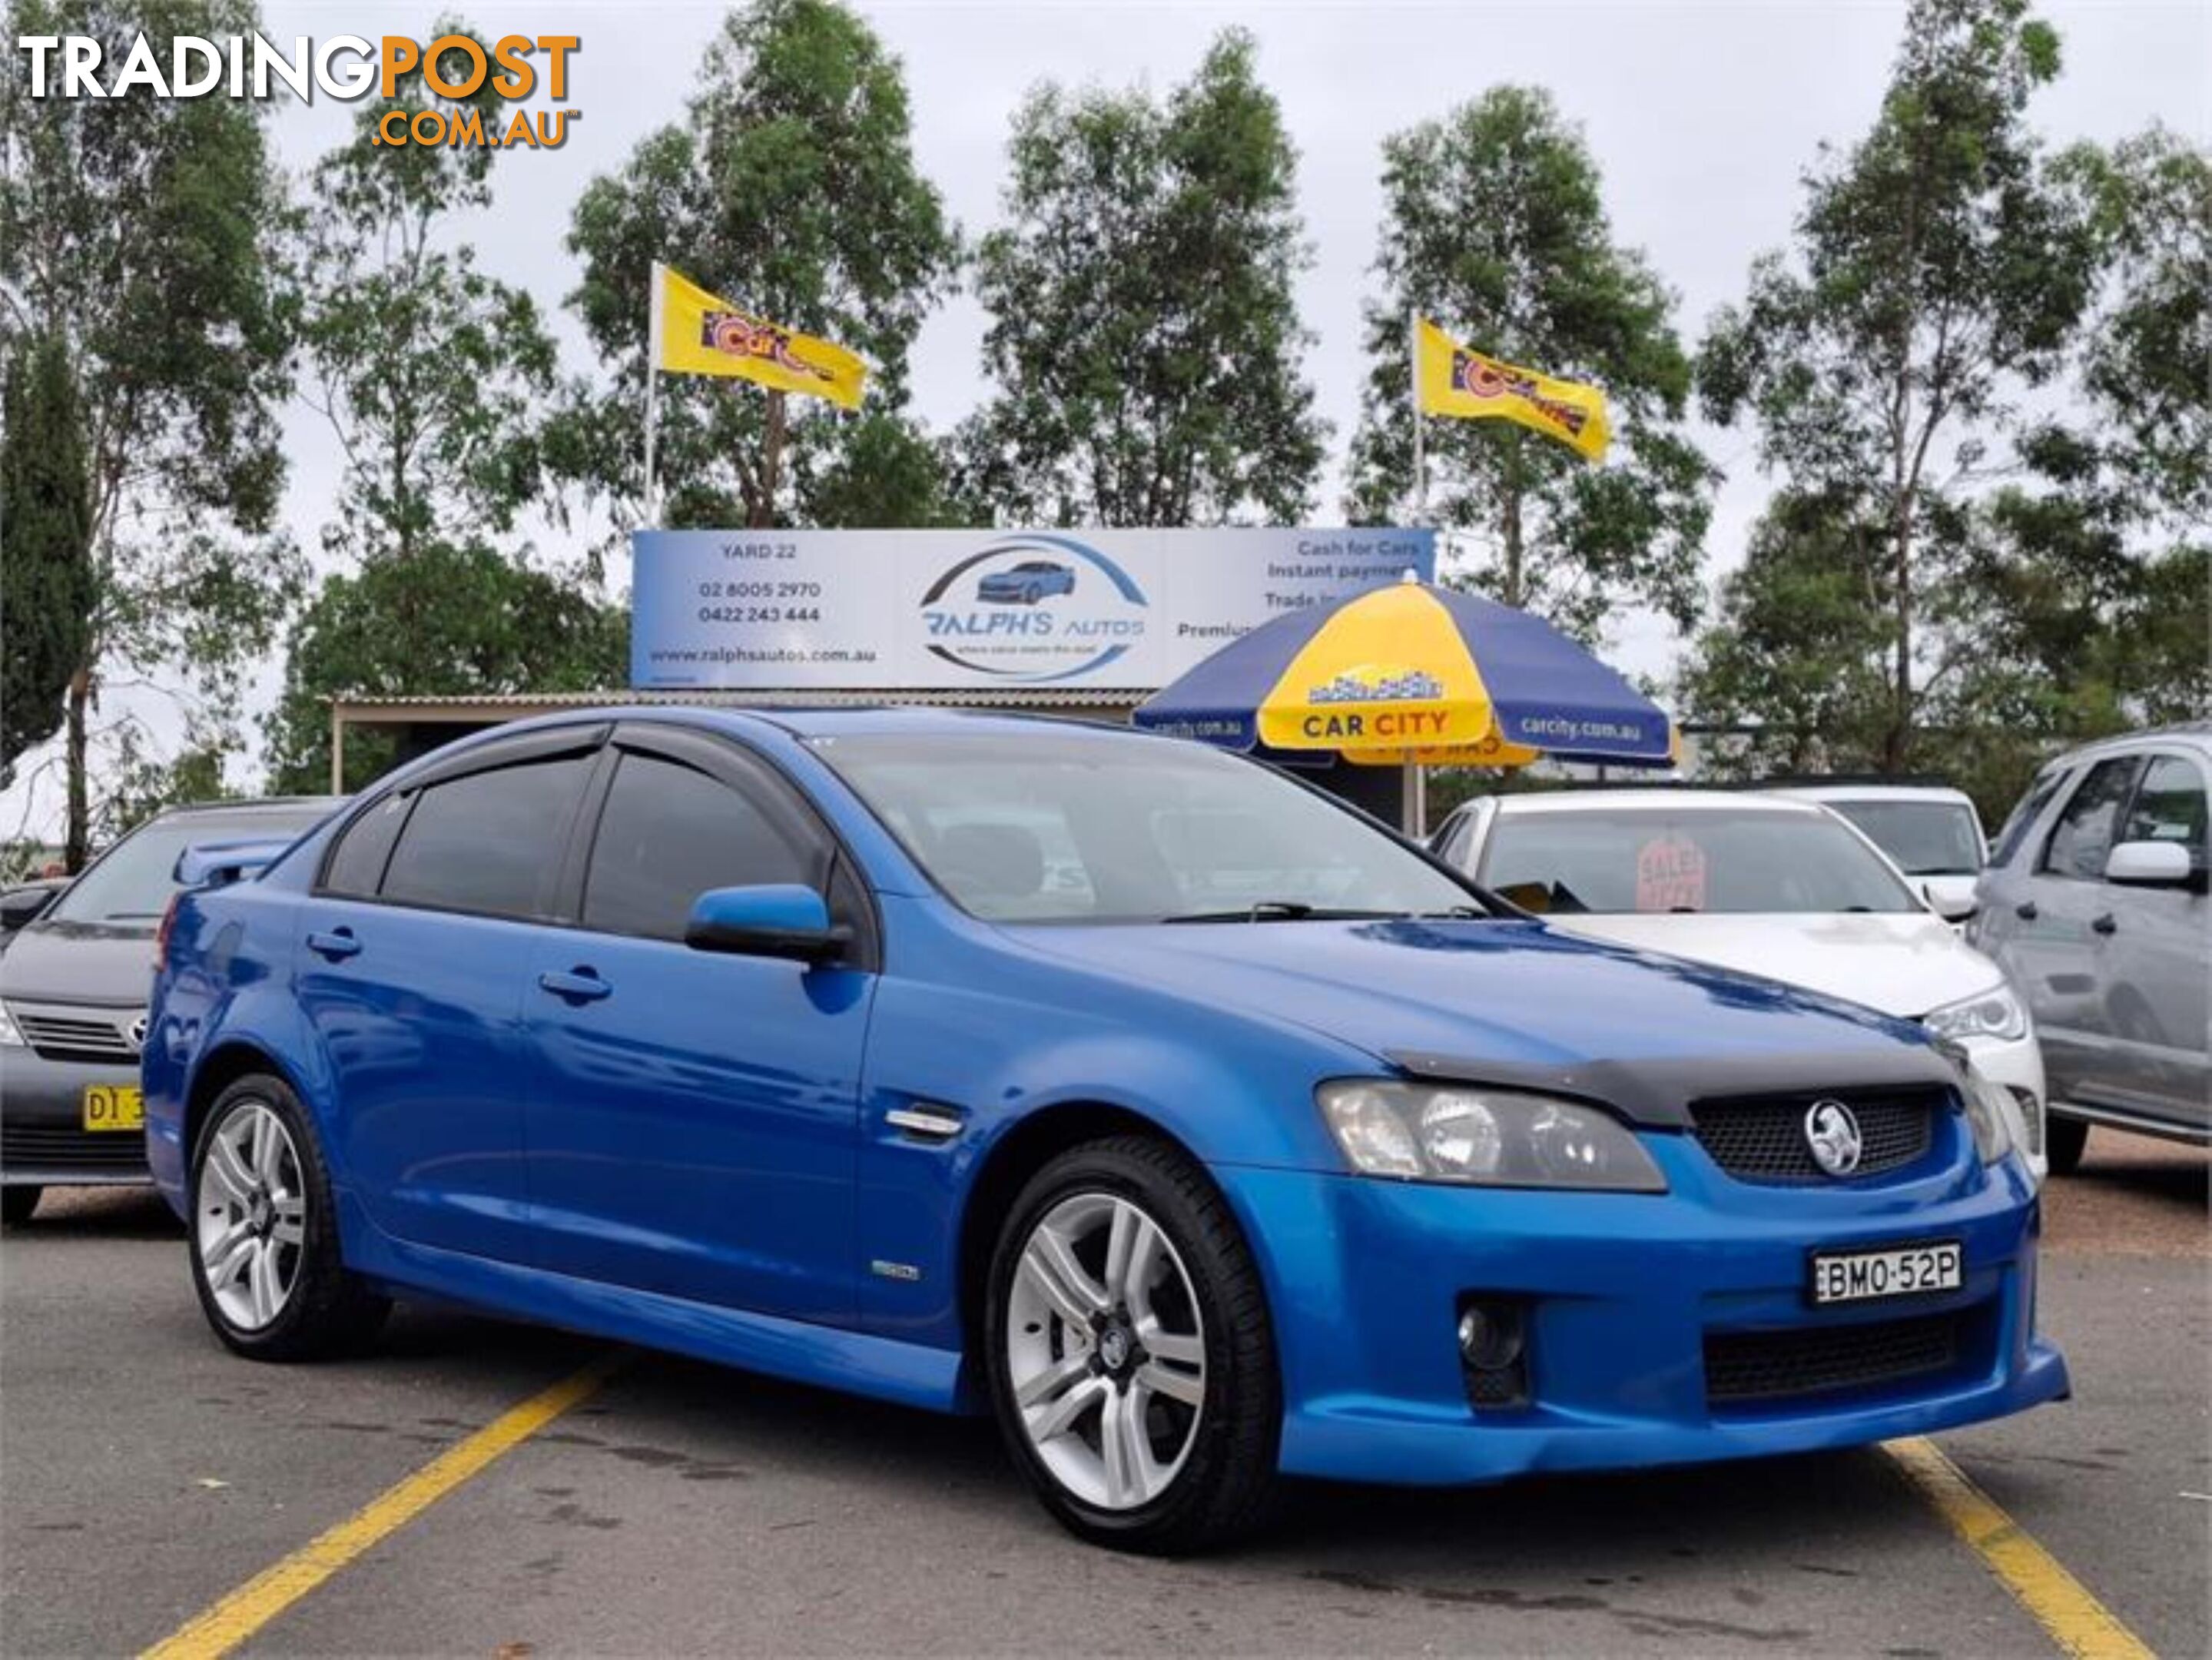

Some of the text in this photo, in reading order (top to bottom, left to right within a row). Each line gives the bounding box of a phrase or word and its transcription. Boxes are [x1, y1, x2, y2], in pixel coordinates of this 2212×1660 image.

[722, 544, 797, 559] YARD 22
[1298, 540, 1418, 555] Cash for Cars
[1267, 563, 1332, 577] Instant
[698, 582, 821, 597] 02 8005 2970
[1264, 592, 1315, 609] Trade
[698, 607, 820, 622] 0422 243 444
[924, 612, 1146, 636] RALPH'S AUTOS
[649, 646, 876, 663] www.ralphsautos.com.au
[1303, 711, 1448, 737] CAR CITY
[1521, 715, 1641, 742] carcity.com.au
